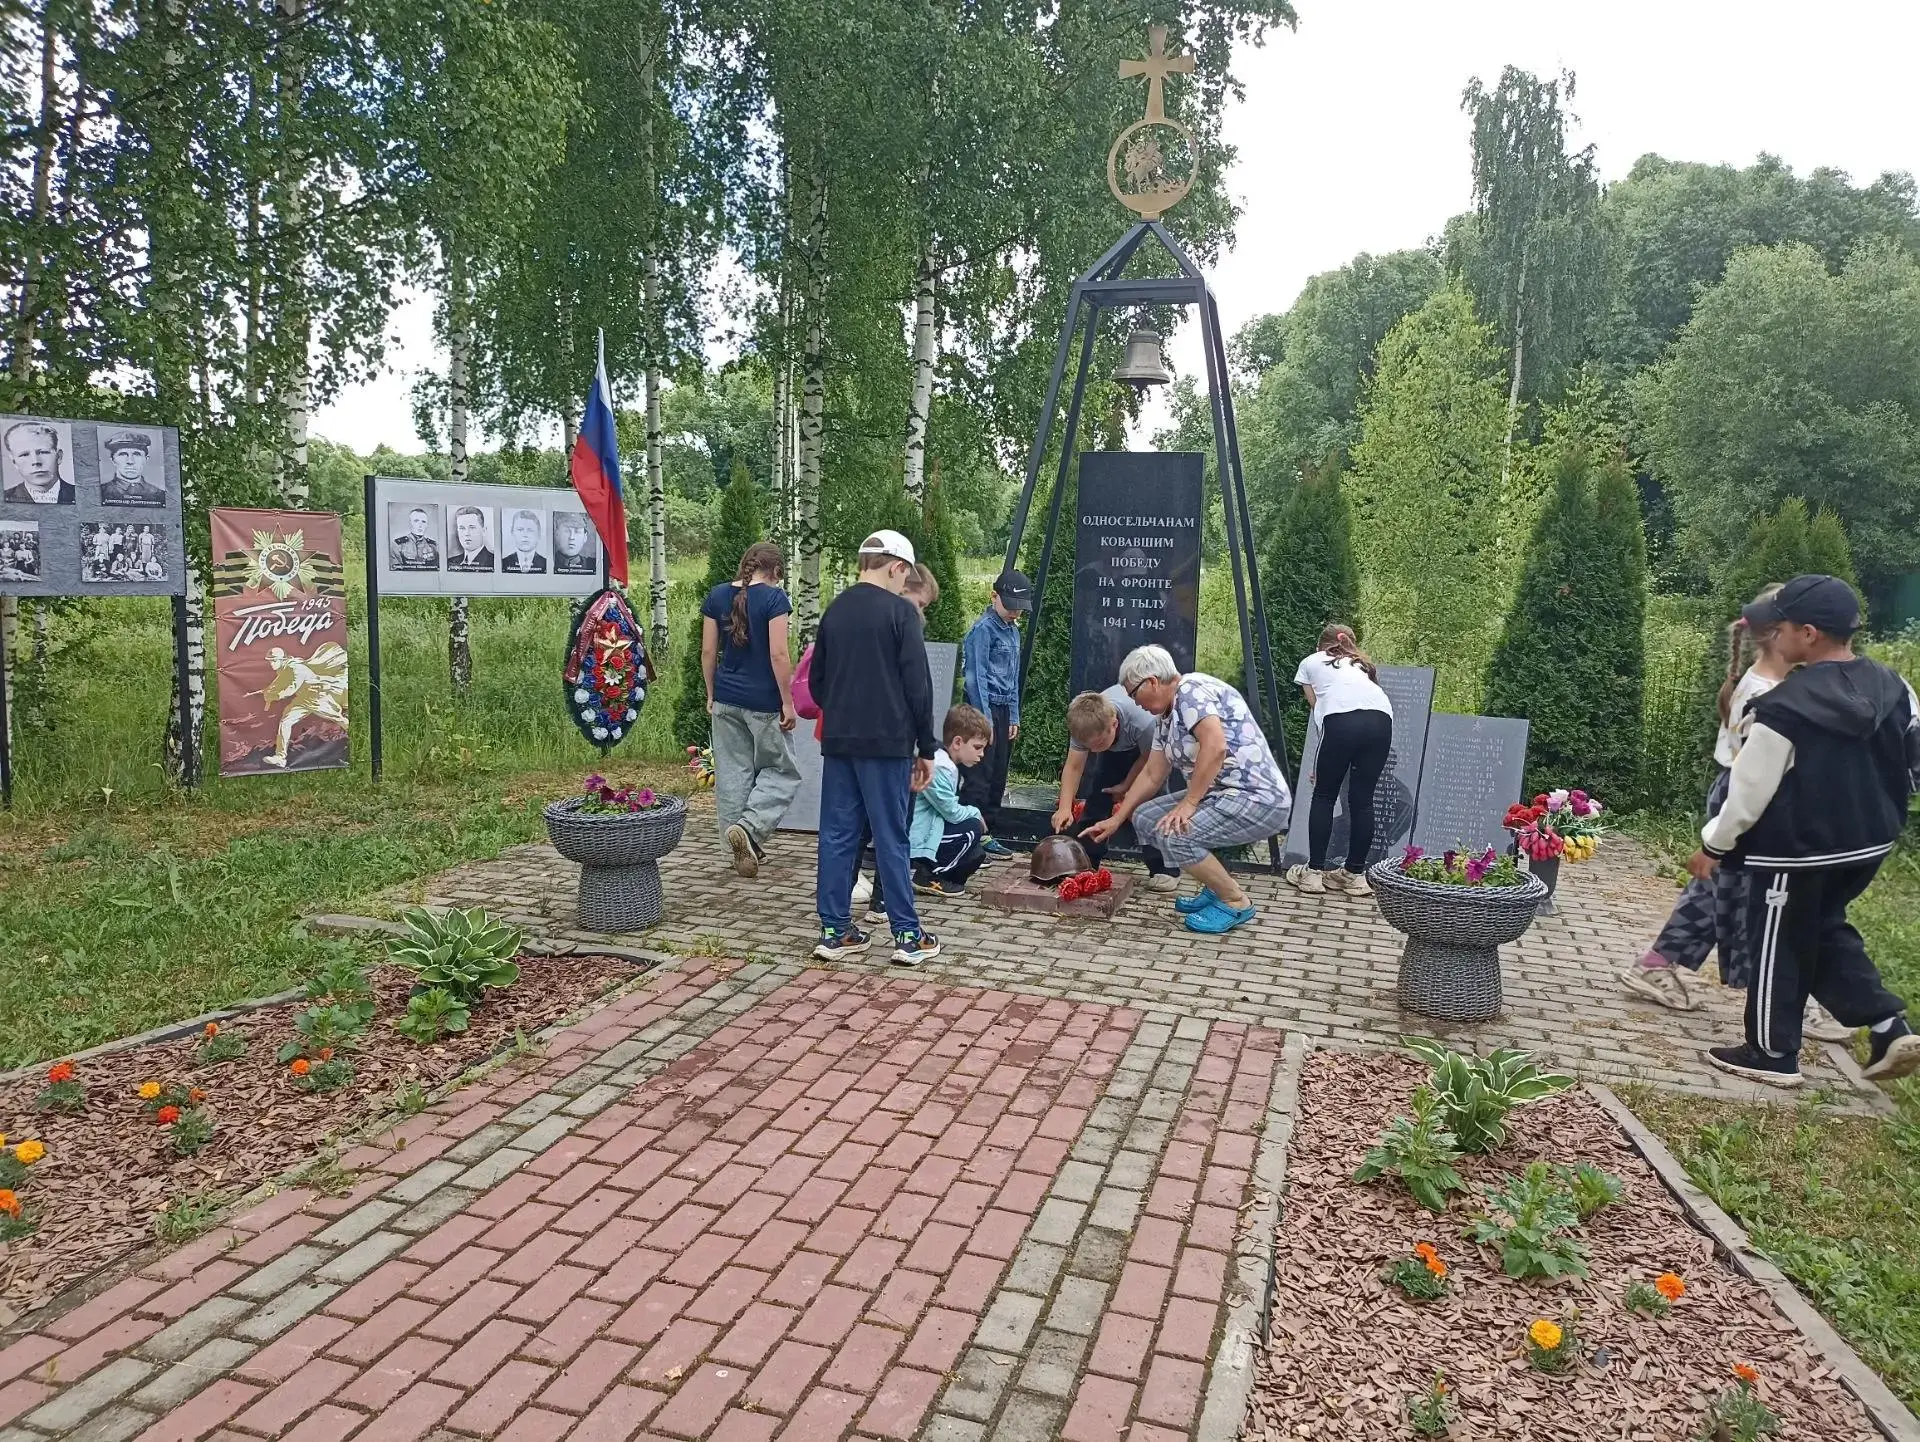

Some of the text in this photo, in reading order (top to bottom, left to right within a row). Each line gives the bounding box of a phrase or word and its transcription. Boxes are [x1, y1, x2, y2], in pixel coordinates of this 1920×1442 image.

[1082, 515, 1195, 528] ОДНОСЕЛЬЧАНАМ
[1100, 536, 1174, 548] КОВАВШИМ
[1111, 557, 1161, 569] ПОБЕДУ
[1098, 576, 1172, 589] НА ФРОНТЕ
[301, 596, 331, 611] 1945
[1102, 597, 1167, 609] И В ТЫЛУ
[228, 601, 334, 652] Победа
[1103, 616, 1127, 628] 1941
[1140, 618, 1166, 630] 1945
